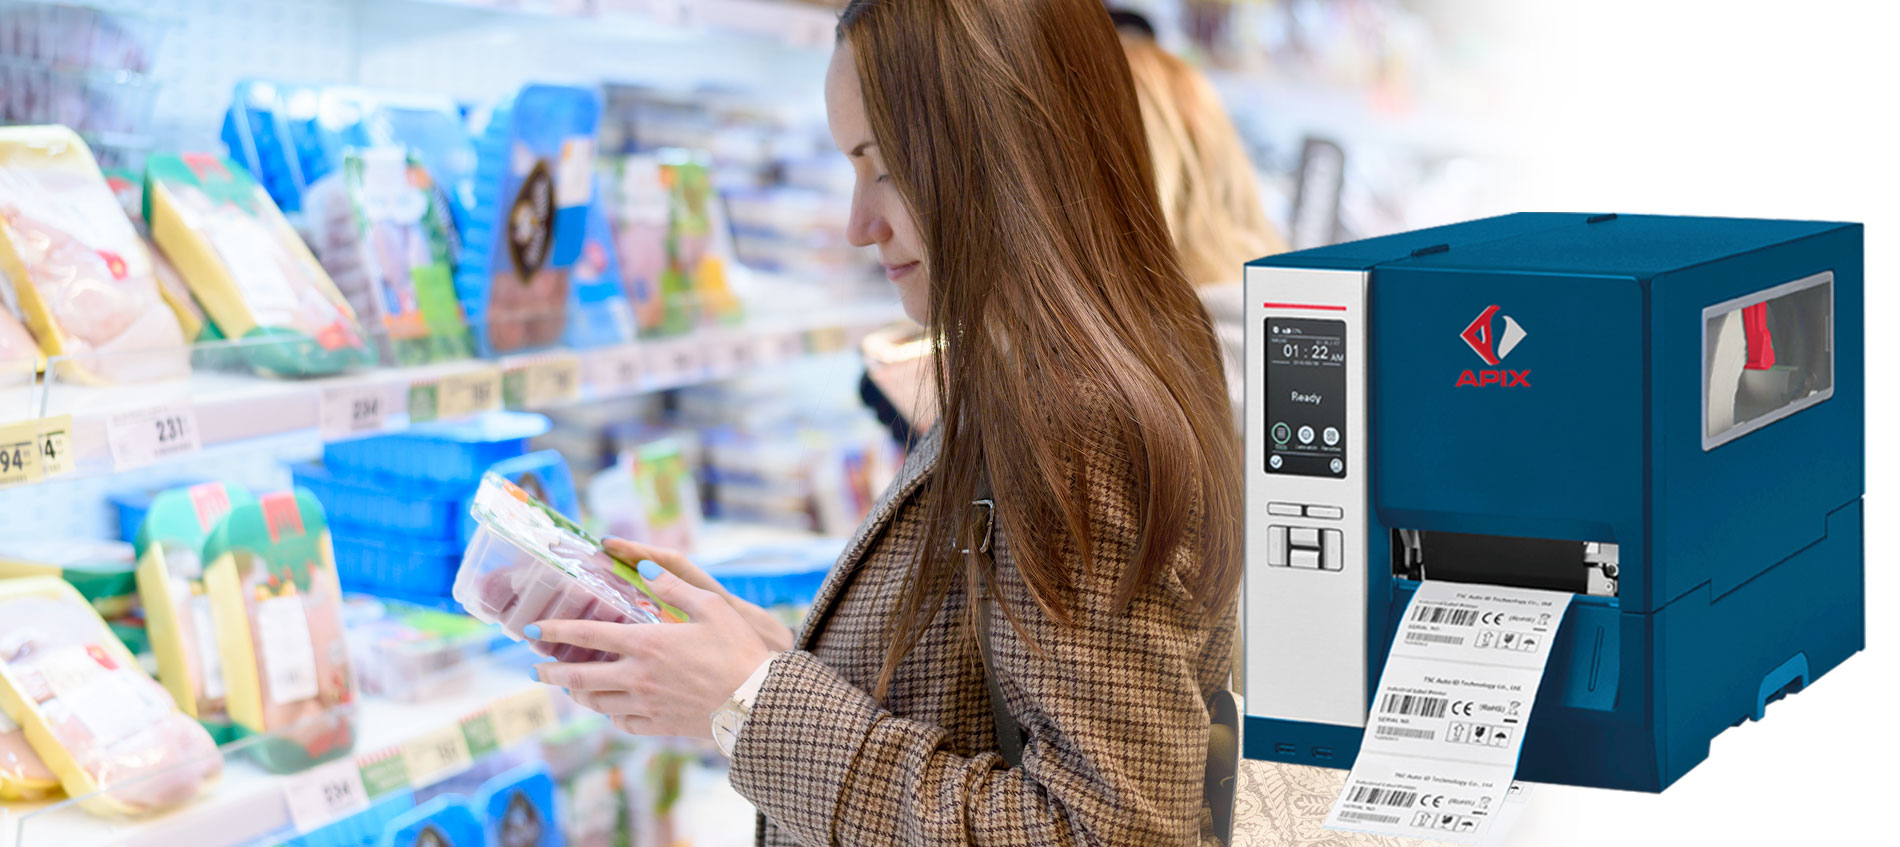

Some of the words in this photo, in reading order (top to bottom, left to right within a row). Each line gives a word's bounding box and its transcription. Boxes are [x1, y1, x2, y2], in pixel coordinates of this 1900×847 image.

[1455, 369, 1531, 387] APIX
[1291, 391, 1322, 405] Ready
[155, 415, 183, 442] 231
[1481, 611, 1504, 625] CE
[1451, 700, 1474, 716] CE
[1420, 794, 1444, 808] CE
